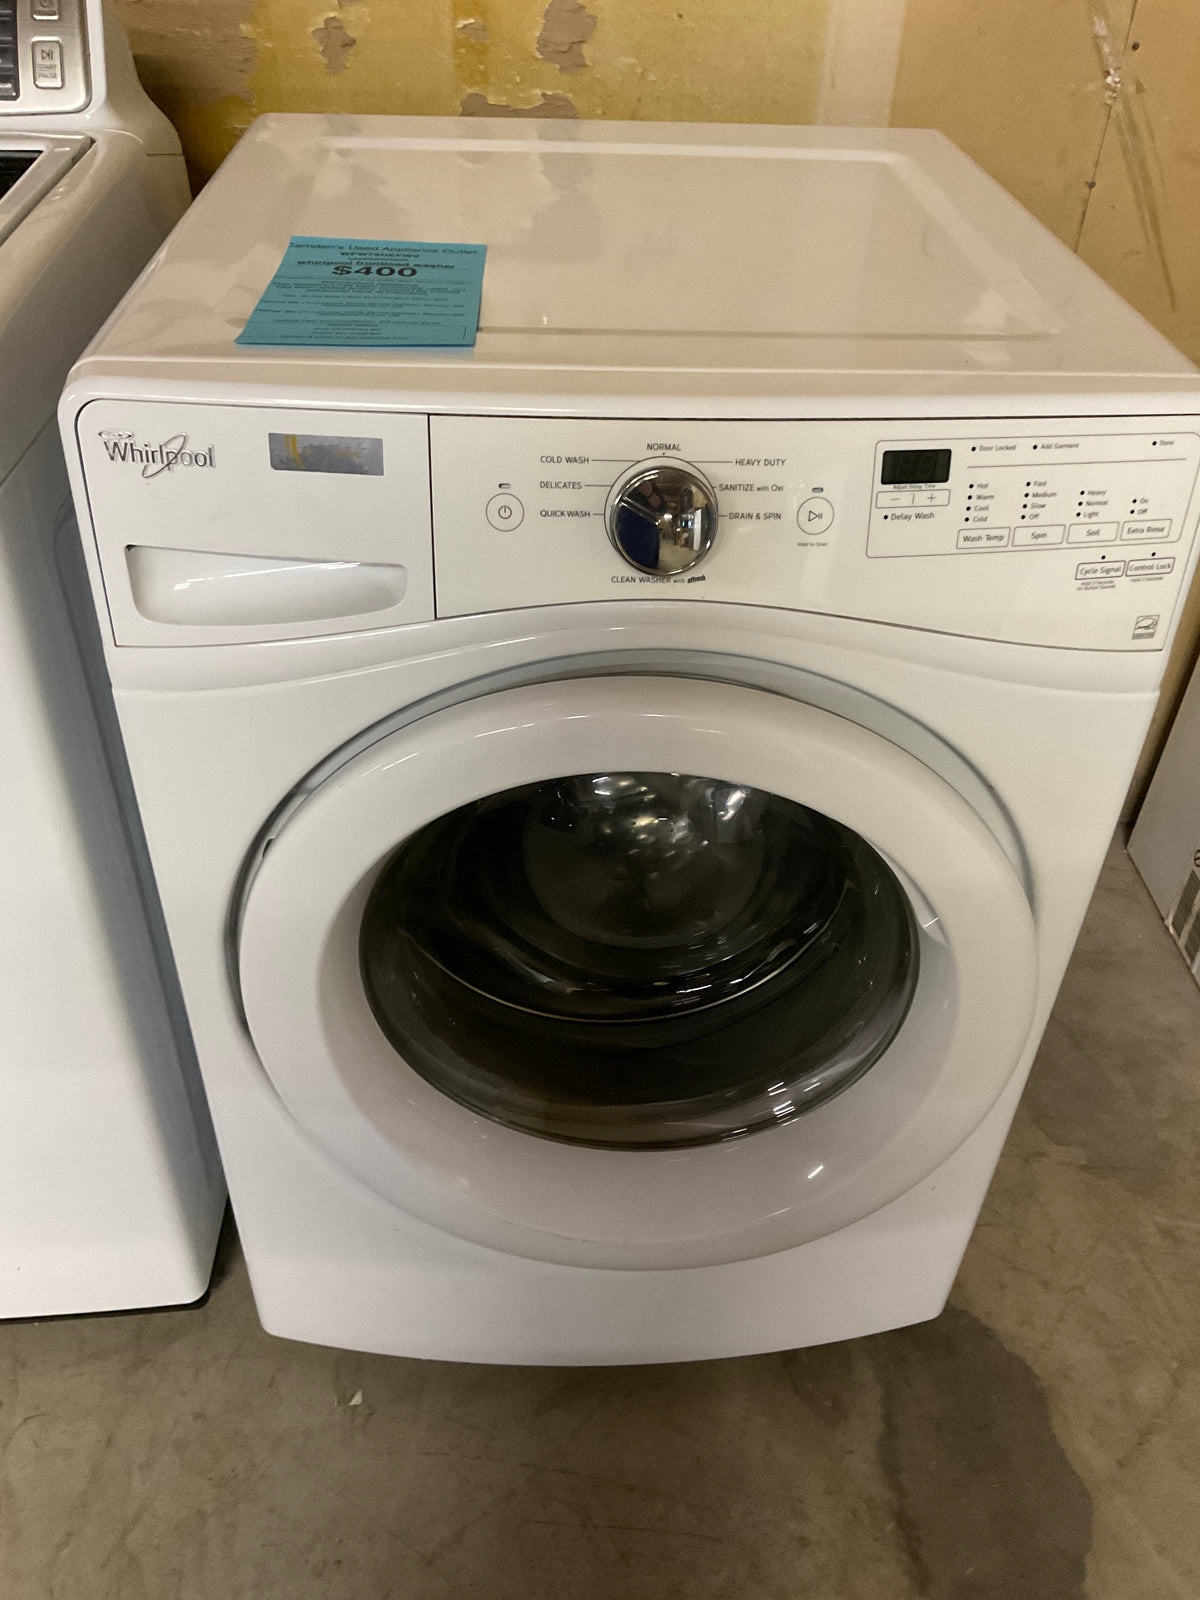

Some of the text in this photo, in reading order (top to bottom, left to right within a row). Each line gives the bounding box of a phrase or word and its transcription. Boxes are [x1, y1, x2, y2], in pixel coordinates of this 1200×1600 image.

[332, 265, 417, 277] $400
[646, 443, 682, 451] NORMAL
[979, 444, 994, 452] Door
[103, 440, 215, 472] Whirlpool
[540, 455, 590, 464] COLD WASH
[735, 458, 786, 467] HEAVY DUTY
[539, 480, 583, 490] DELICATES
[718, 483, 755, 492] SANITIZE
[771, 484, 784, 492] Oxi
[1088, 490, 1107, 499] Heavy
[974, 504, 990, 512] Cool
[540, 509, 591, 518] QUICK WASH
[728, 512, 782, 520] DRAIN & SPIN
[890, 511, 935, 522] Delay Wash
[1083, 511, 1099, 519] Light
[973, 515, 988, 523] Cold
[1031, 531, 1048, 540] Spin
[1086, 528, 1100, 537] Soil
[1127, 527, 1145, 535] Extra
[985, 534, 1005, 542] Temp
[1080, 566, 1122, 577] Cycle Signal
[1128, 562, 1171, 572] Control Lock
[611, 575, 636, 584] CLEAN
[638, 575, 672, 584] WASHER
